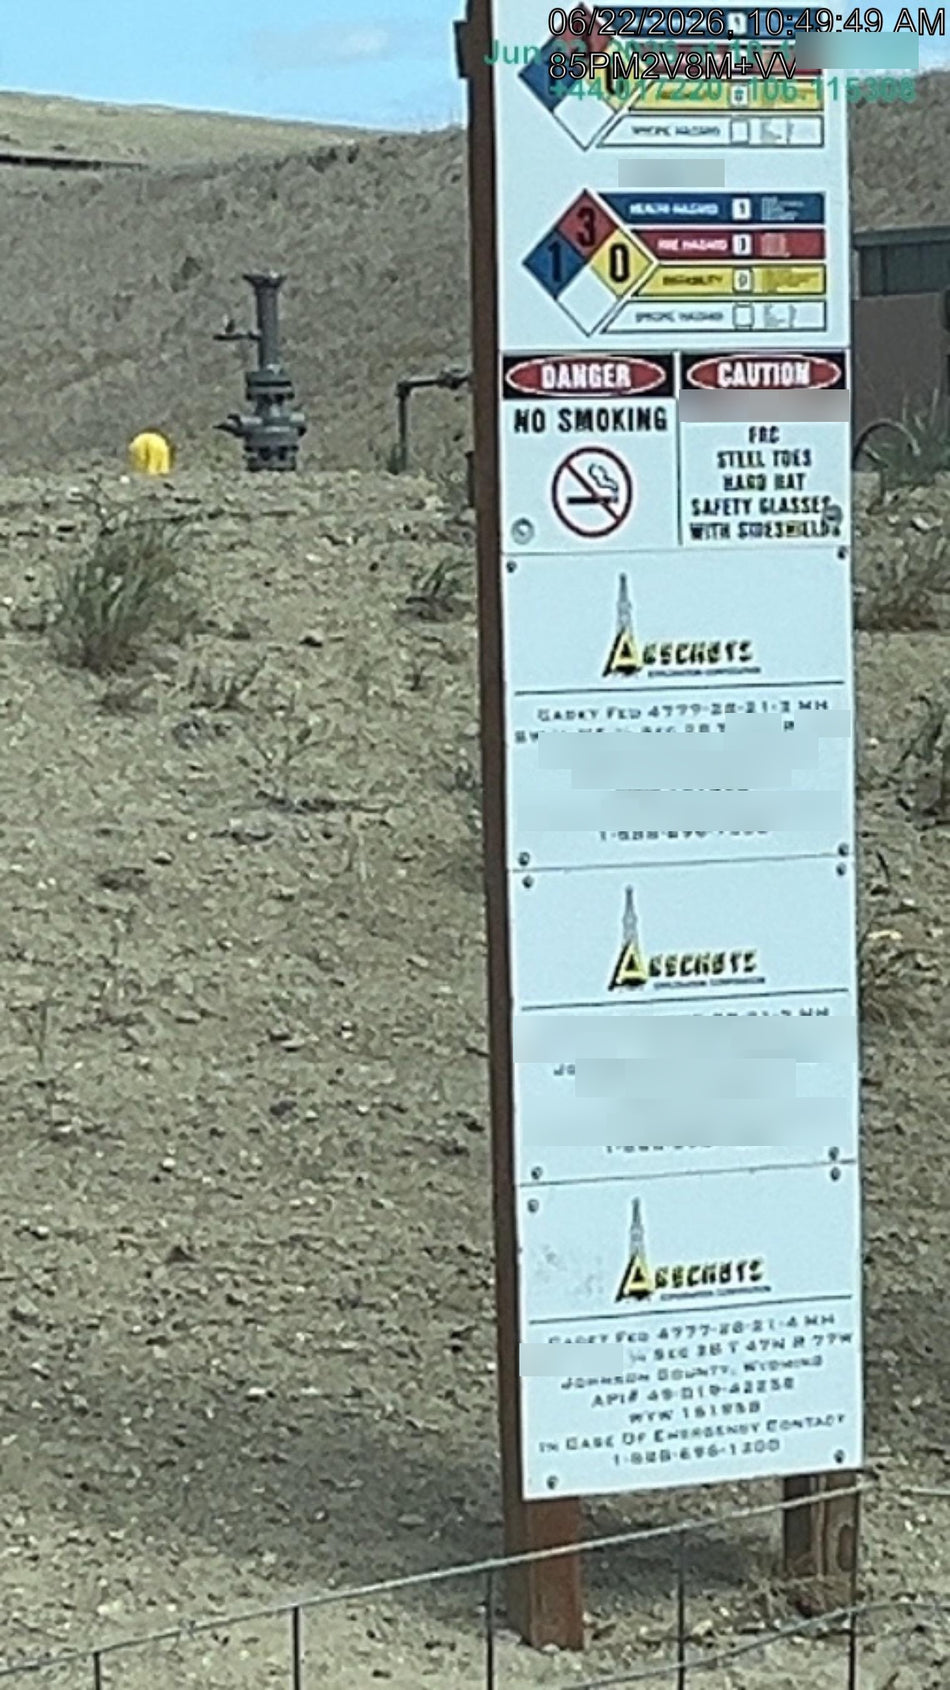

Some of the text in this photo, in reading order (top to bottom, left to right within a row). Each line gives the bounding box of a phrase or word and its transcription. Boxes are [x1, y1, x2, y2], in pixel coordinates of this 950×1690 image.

[576, 206, 596, 247] 3
[550, 241, 562, 283] 1
[610, 243, 629, 284] 0
[541, 364, 632, 389] DANGER
[717, 361, 811, 386] CAUTION
[514, 407, 668, 434] NO SMOKING
[717, 448, 812, 469] STEEL TOES
[691, 498, 752, 516] SAFETY
[690, 522, 731, 540] WITH
